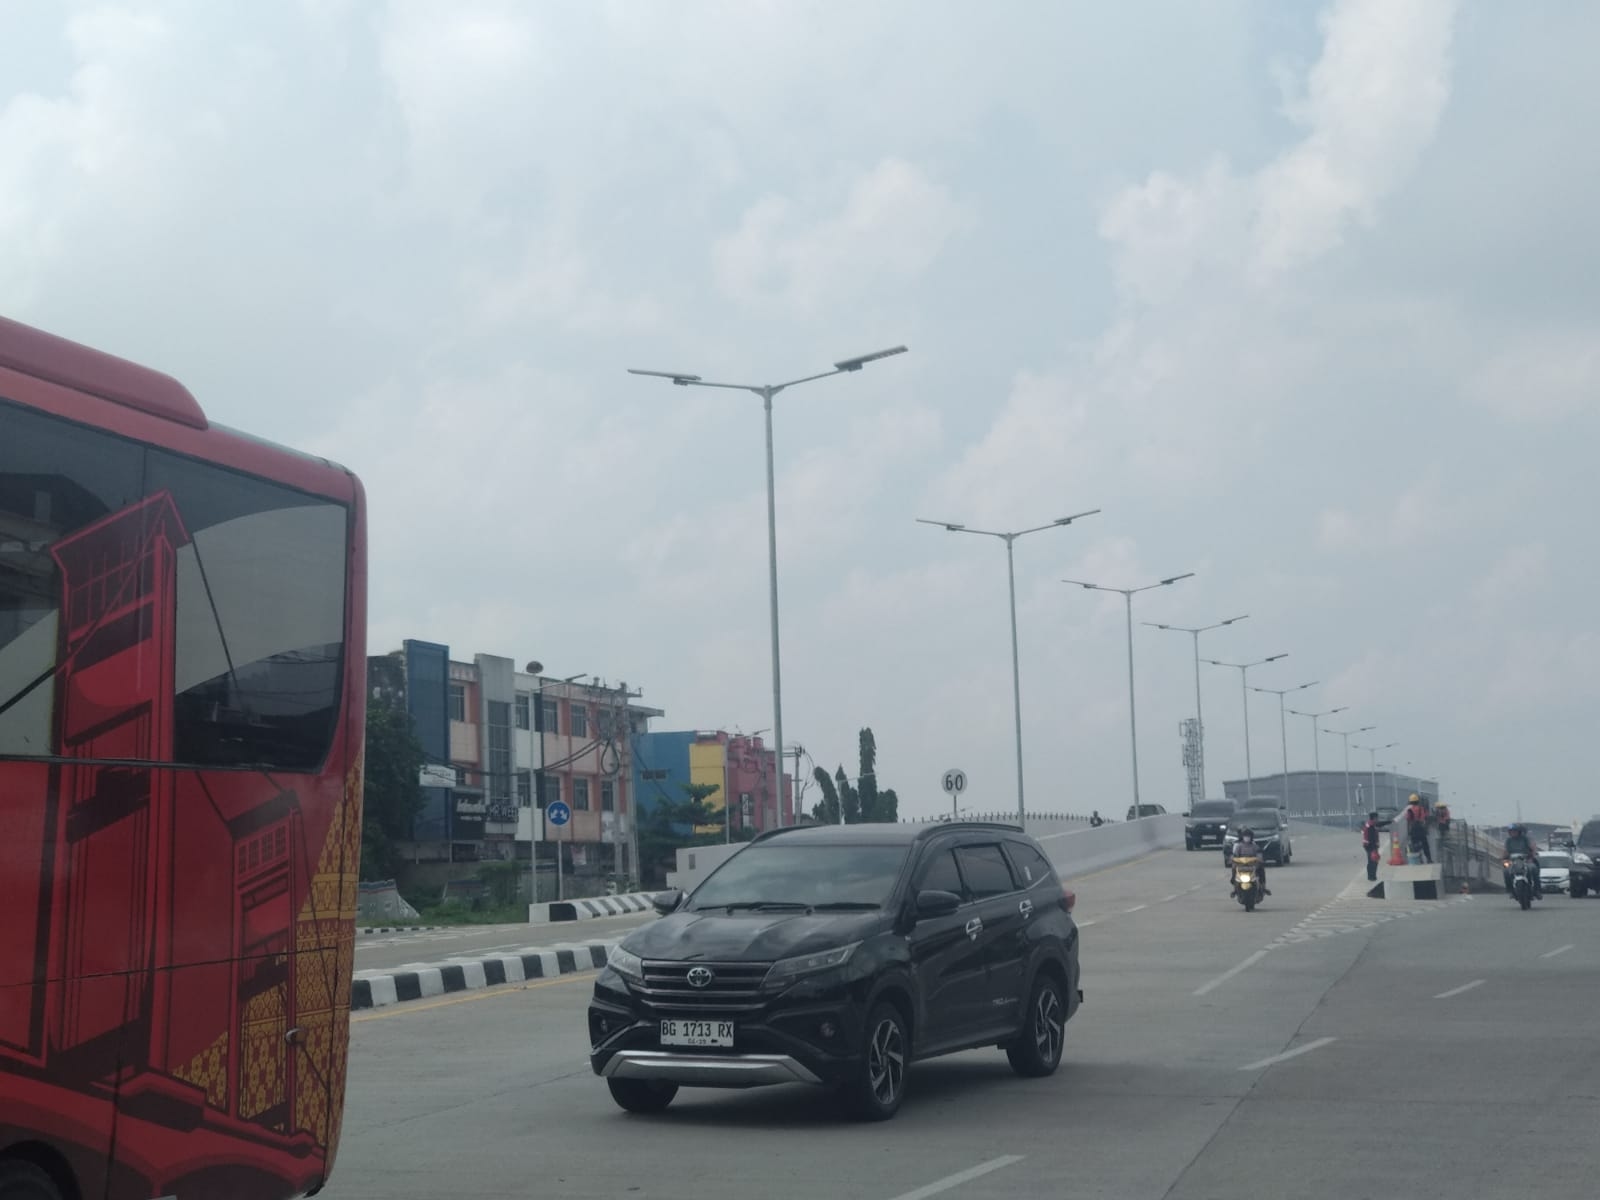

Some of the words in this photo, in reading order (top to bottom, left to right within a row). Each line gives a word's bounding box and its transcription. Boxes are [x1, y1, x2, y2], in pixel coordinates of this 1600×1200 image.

[945, 774, 963, 791] 60
[662, 1022, 676, 1036] BG
[683, 1023, 711, 1037] 1713
[718, 1024, 732, 1038] RX
